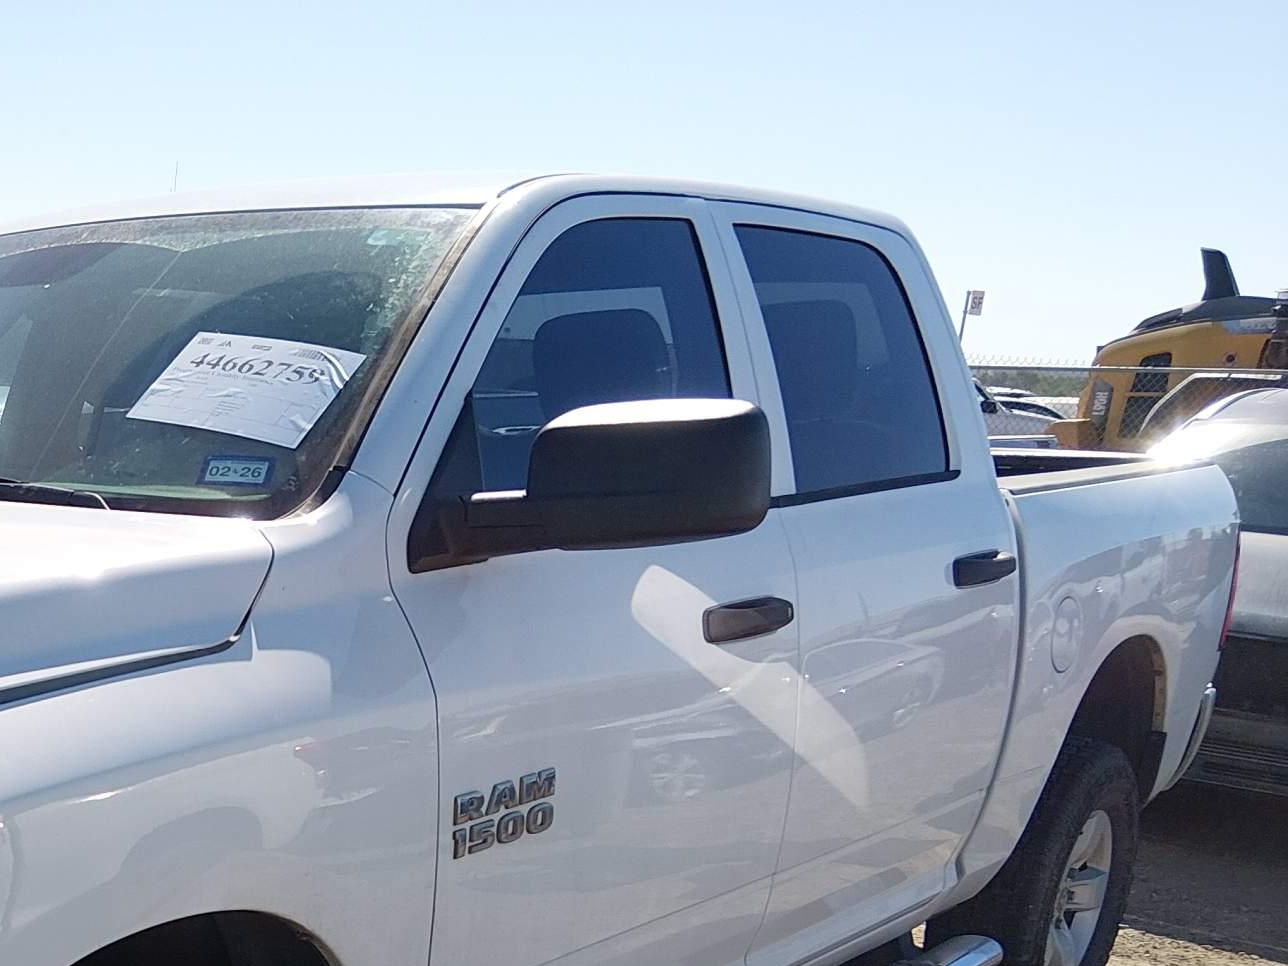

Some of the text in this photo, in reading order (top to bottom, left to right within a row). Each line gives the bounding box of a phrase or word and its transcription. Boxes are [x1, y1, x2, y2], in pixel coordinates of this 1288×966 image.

[190, 352, 326, 385] 44662759
[453, 767, 556, 826] RAM
[453, 802, 554, 860] 1500
